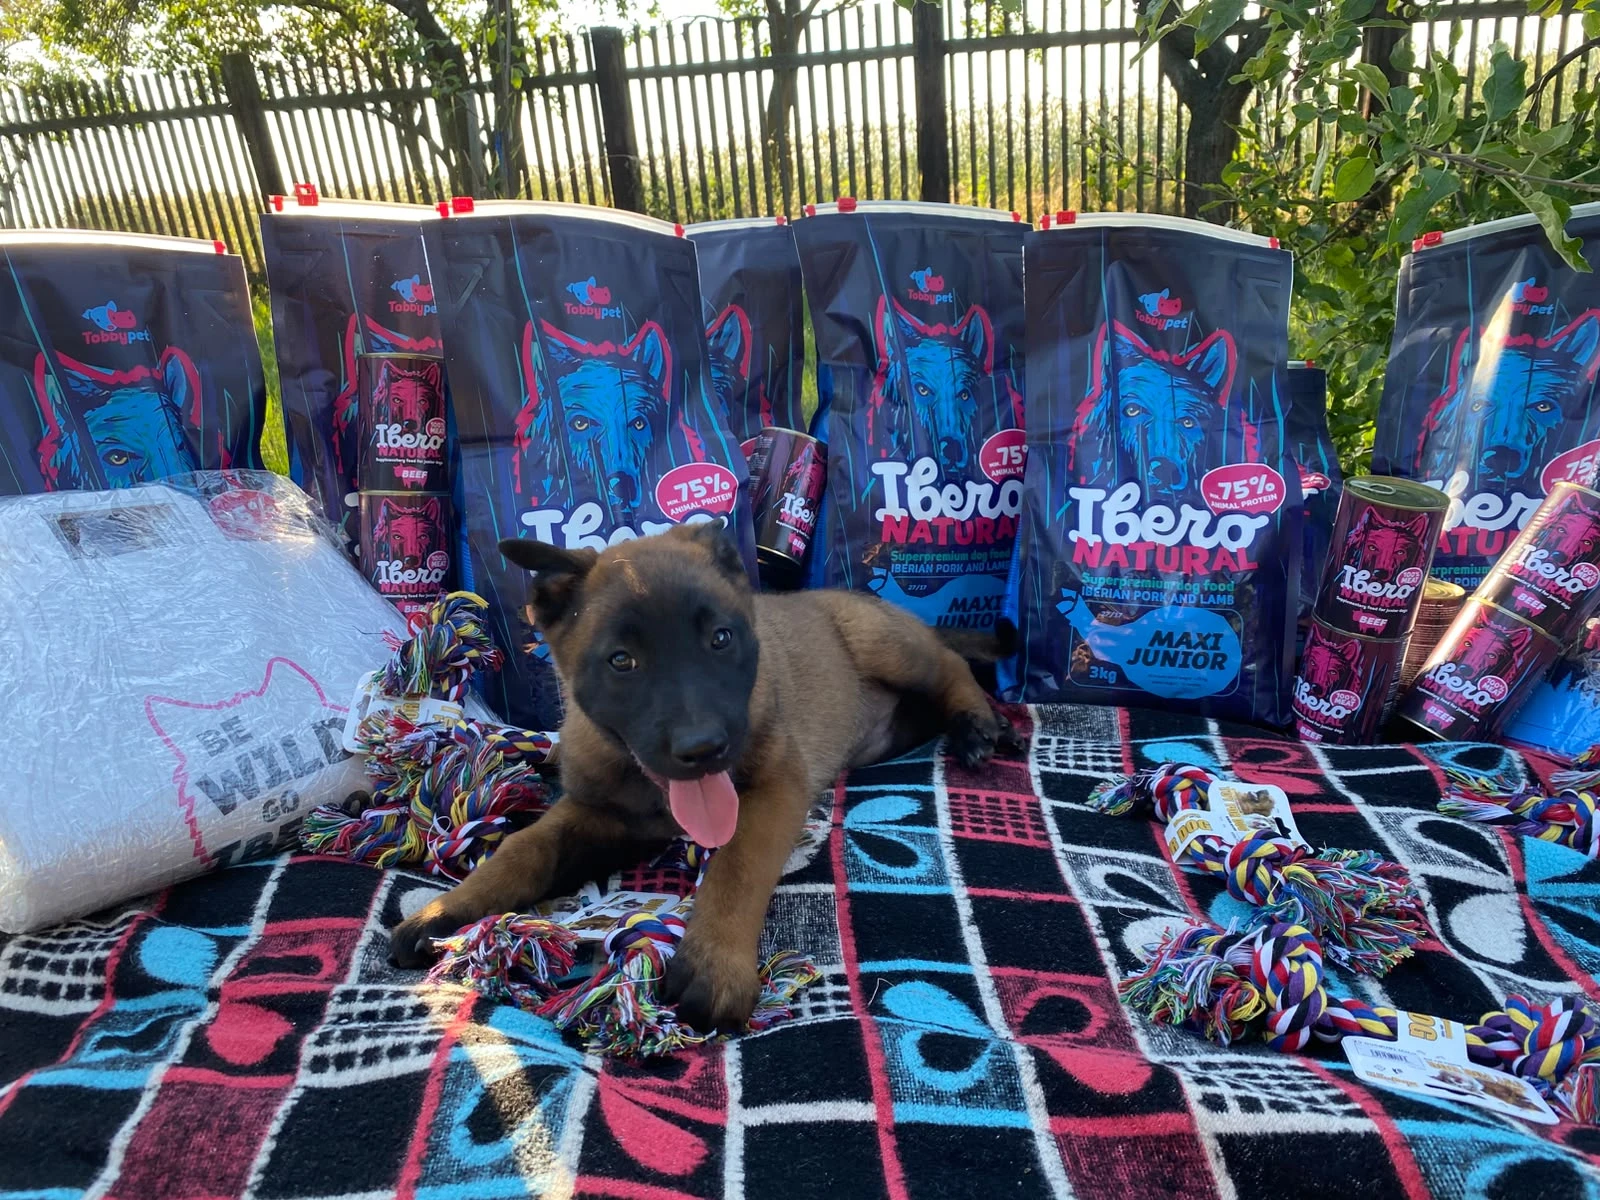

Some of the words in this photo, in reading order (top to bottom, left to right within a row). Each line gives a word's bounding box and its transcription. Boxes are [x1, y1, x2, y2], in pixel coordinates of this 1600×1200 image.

[908, 289, 953, 306] Tobbypet
[388, 301, 438, 317] Tobbype
[564, 302, 621, 320] Tobbypet
[1135, 309, 1188, 331] Tobbypet
[82, 330, 150, 346] Tobbypet
[375, 423, 445, 450] Ibero
[378, 446, 441, 458] NATURAL
[402, 470, 428, 478] BEEF
[674, 473, 731, 502] 75%
[871, 456, 1025, 522] Ibero
[1217, 474, 1275, 501] 75%
[670, 502, 701, 516] ANIMAL
[701, 492, 734, 508] PROTEIN
[1210, 500, 1239, 511] ANIMAL
[1241, 493, 1277, 508] PROTEIN
[1068, 482, 1269, 553] Ibero
[881, 514, 1020, 546] NATURA
[890, 550, 969, 565] Superpremium
[1072, 536, 1258, 577] NATURAL
[377, 560, 446, 584] Ibero
[890, 563, 933, 574] IBERIAN
[936, 563, 963, 573] PORK
[966, 562, 984, 572] AND
[1430, 563, 1491, 577] erpremium
[1513, 544, 1587, 593] Ibero
[1081, 572, 1176, 590] Superpremium
[1176, 579, 1200, 595] dog
[1203, 579, 1235, 592] food
[1340, 565, 1416, 599] Ibero
[1081, 585, 1130, 600] IBERIAN
[1133, 590, 1166, 603] PORK
[1170, 593, 1197, 604] AND
[1200, 594, 1235, 606] LAMB
[1340, 587, 1407, 608] NATURAL
[1517, 593, 1547, 611] BEEF
[936, 613, 999, 629] JUNIO
[1359, 615, 1388, 627] BEEF
[1148, 630, 1224, 651] MAXI
[1126, 648, 1228, 671] JUNIOR
[1089, 665, 1118, 684] 3kg
[1425, 661, 1495, 706] Ibero
[1334, 697, 1356, 707] MEAT
[1422, 677, 1481, 715] NATURAL
[1427, 705, 1456, 723] BEEF
[196, 716, 253, 757] BE
[195, 717, 355, 817] WILD
[262, 789, 301, 823] GO
[1176, 819, 1213, 844] DOG
